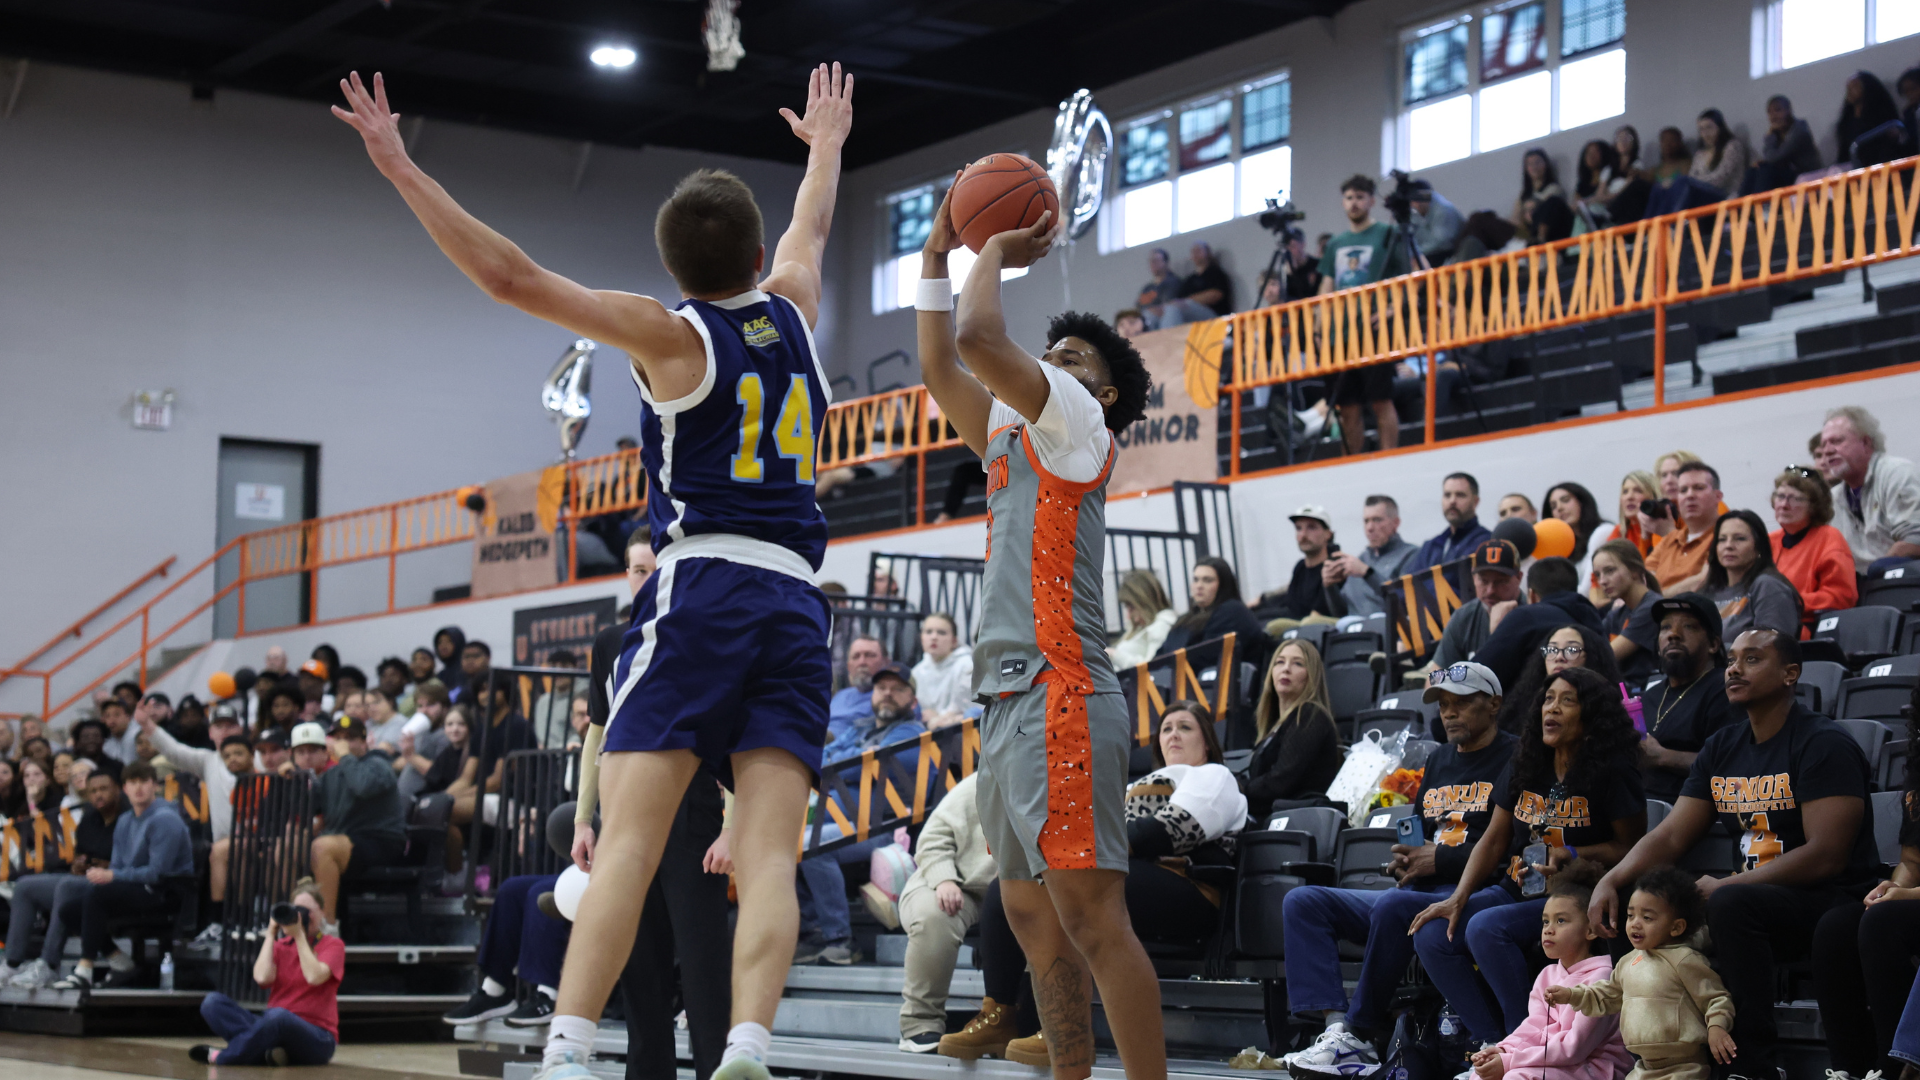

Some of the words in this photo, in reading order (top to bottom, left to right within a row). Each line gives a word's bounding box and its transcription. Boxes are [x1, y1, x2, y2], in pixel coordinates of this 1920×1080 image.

[744, 316, 770, 332] AAC
[730, 372, 816, 486] 14
[1118, 414, 1199, 449] ONNOR
[1486, 546, 1503, 564] U
[1710, 772, 1794, 802] SENIOR
[1714, 801, 1738, 813] ALEB
[1746, 811, 1784, 869] 4
